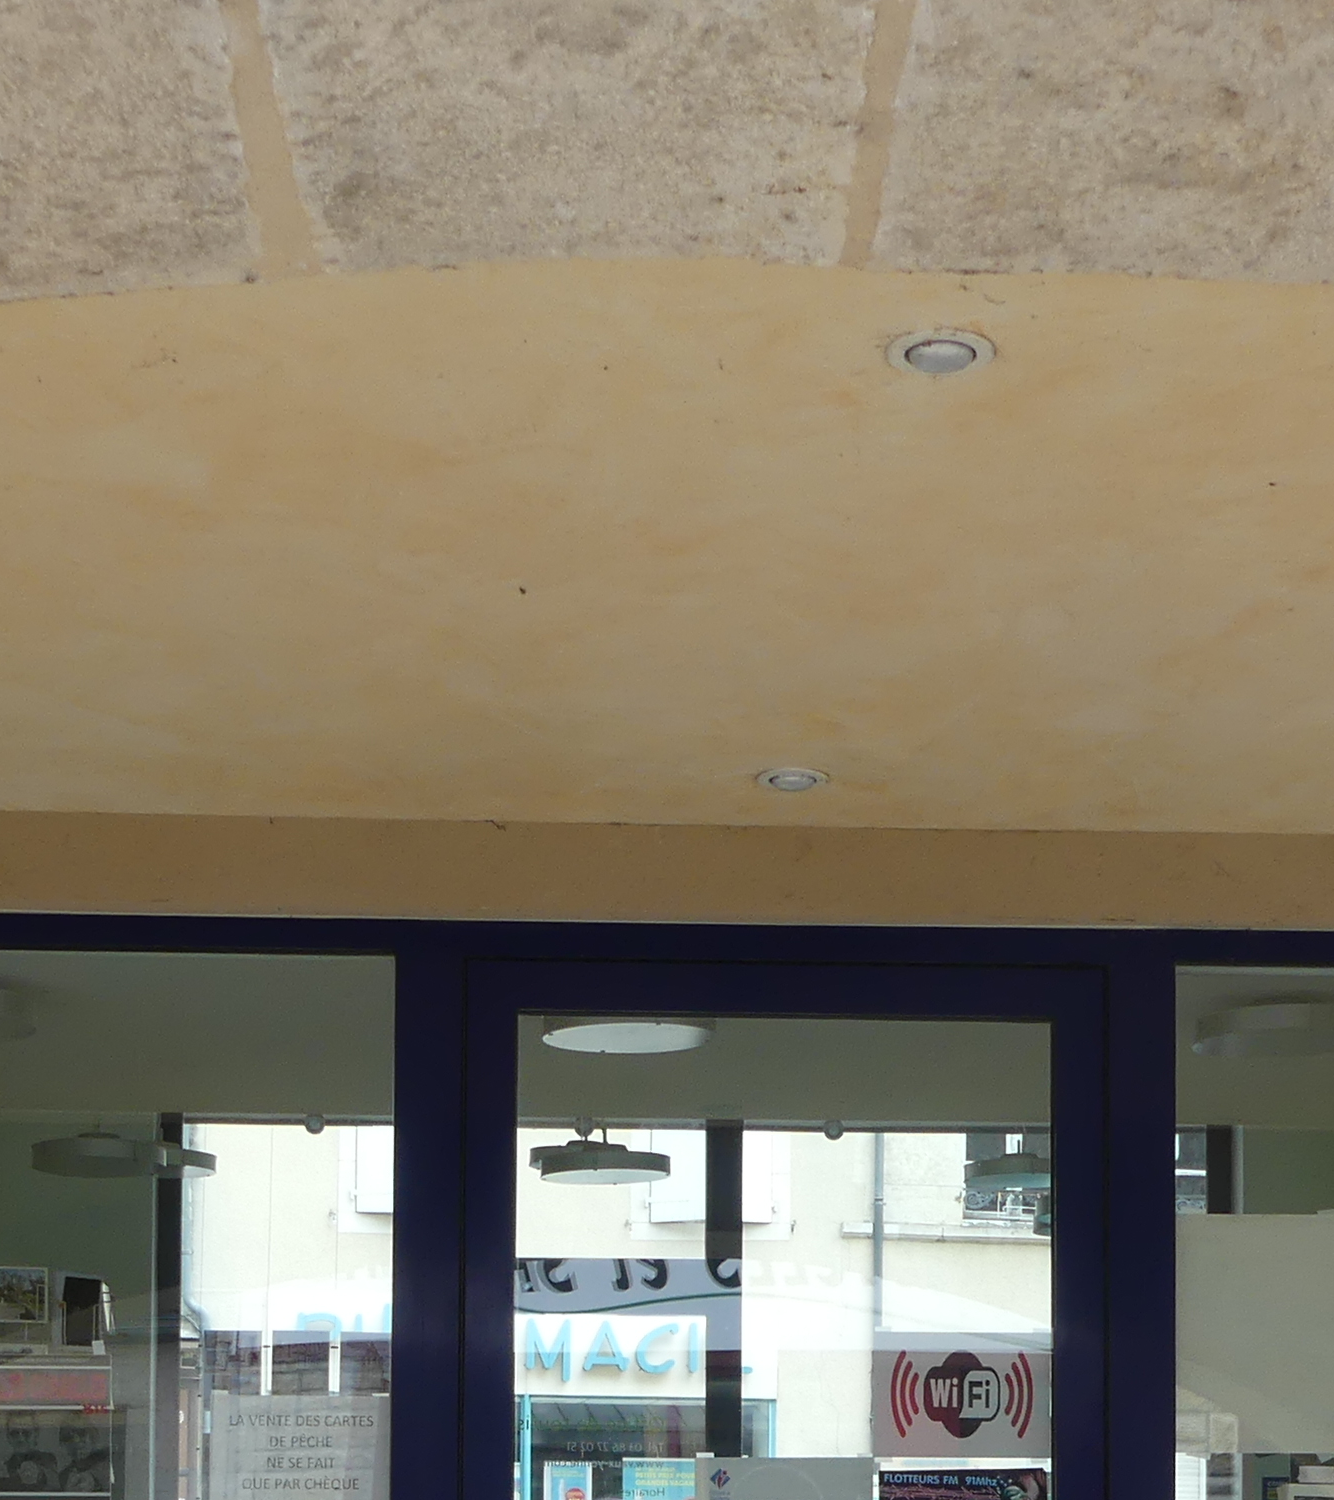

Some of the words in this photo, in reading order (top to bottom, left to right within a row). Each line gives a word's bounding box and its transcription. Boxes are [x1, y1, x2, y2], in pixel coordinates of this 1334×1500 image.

[229, 1415, 245, 1427] LA
[248, 1415, 292, 1428] VENTE
[295, 1416, 321, 1428] DES
[324, 1415, 375, 1429] CARTES
[269, 1436, 288, 1448] DE
[291, 1433, 334, 1448] PÊCHE
[266, 1457, 284, 1469] NE
[288, 1457, 303, 1469] SE
[307, 1457, 335, 1469] FAIT
[242, 1478, 270, 1491] QUE
[274, 1478, 301, 1490] PAR
[304, 1475, 360, 1491] CHÈQUE
[884, 1473, 940, 1485] FLOTTEURS
[942, 1476, 959, 1486] FM
[965, 1476, 998, 1487] 91Mhz
